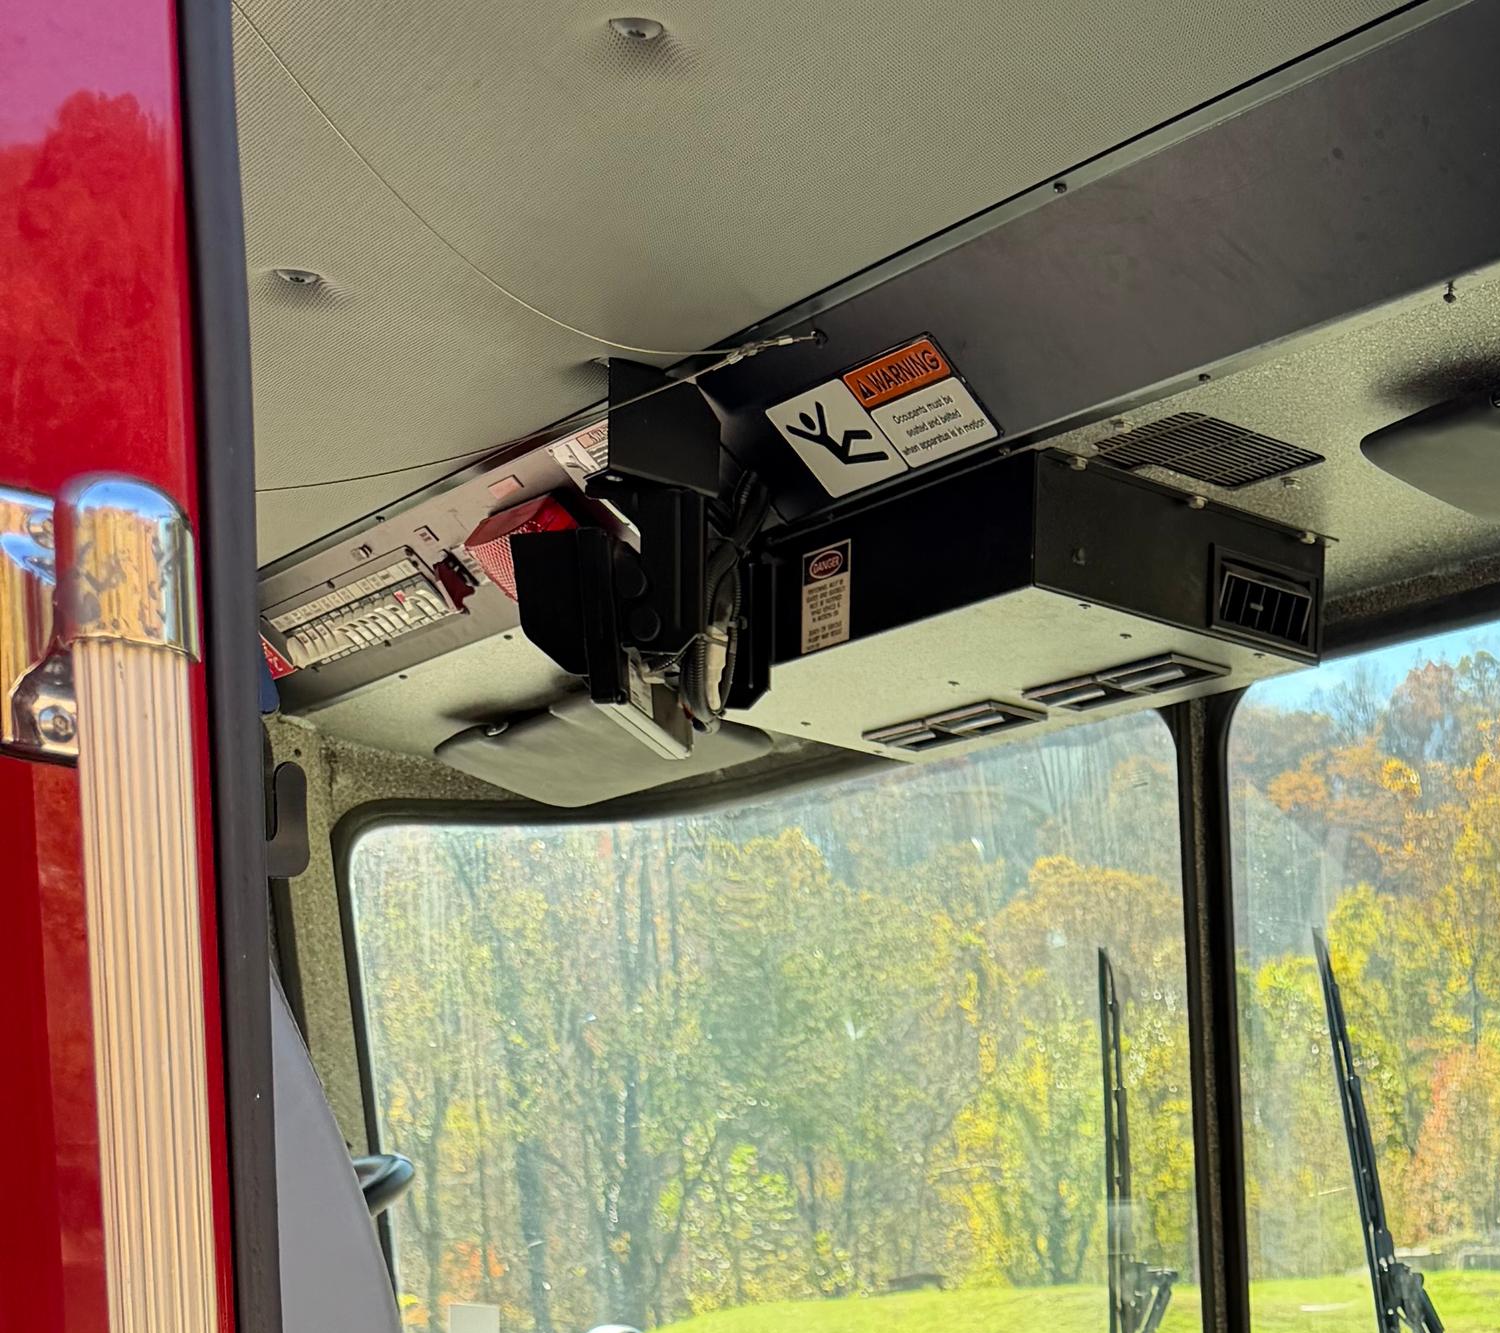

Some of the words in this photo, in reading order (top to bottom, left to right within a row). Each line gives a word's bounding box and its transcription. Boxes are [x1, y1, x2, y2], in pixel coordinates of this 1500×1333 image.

[867, 350, 940, 394] WARNING
[892, 405, 927, 424] Occupants
[926, 399, 944, 411] must
[940, 395, 954, 404] be
[902, 444, 920, 456] when
[919, 432, 951, 449] apparatus
[963, 418, 986, 432] motion
[906, 422, 928, 437] seated
[927, 416, 942, 428] and
